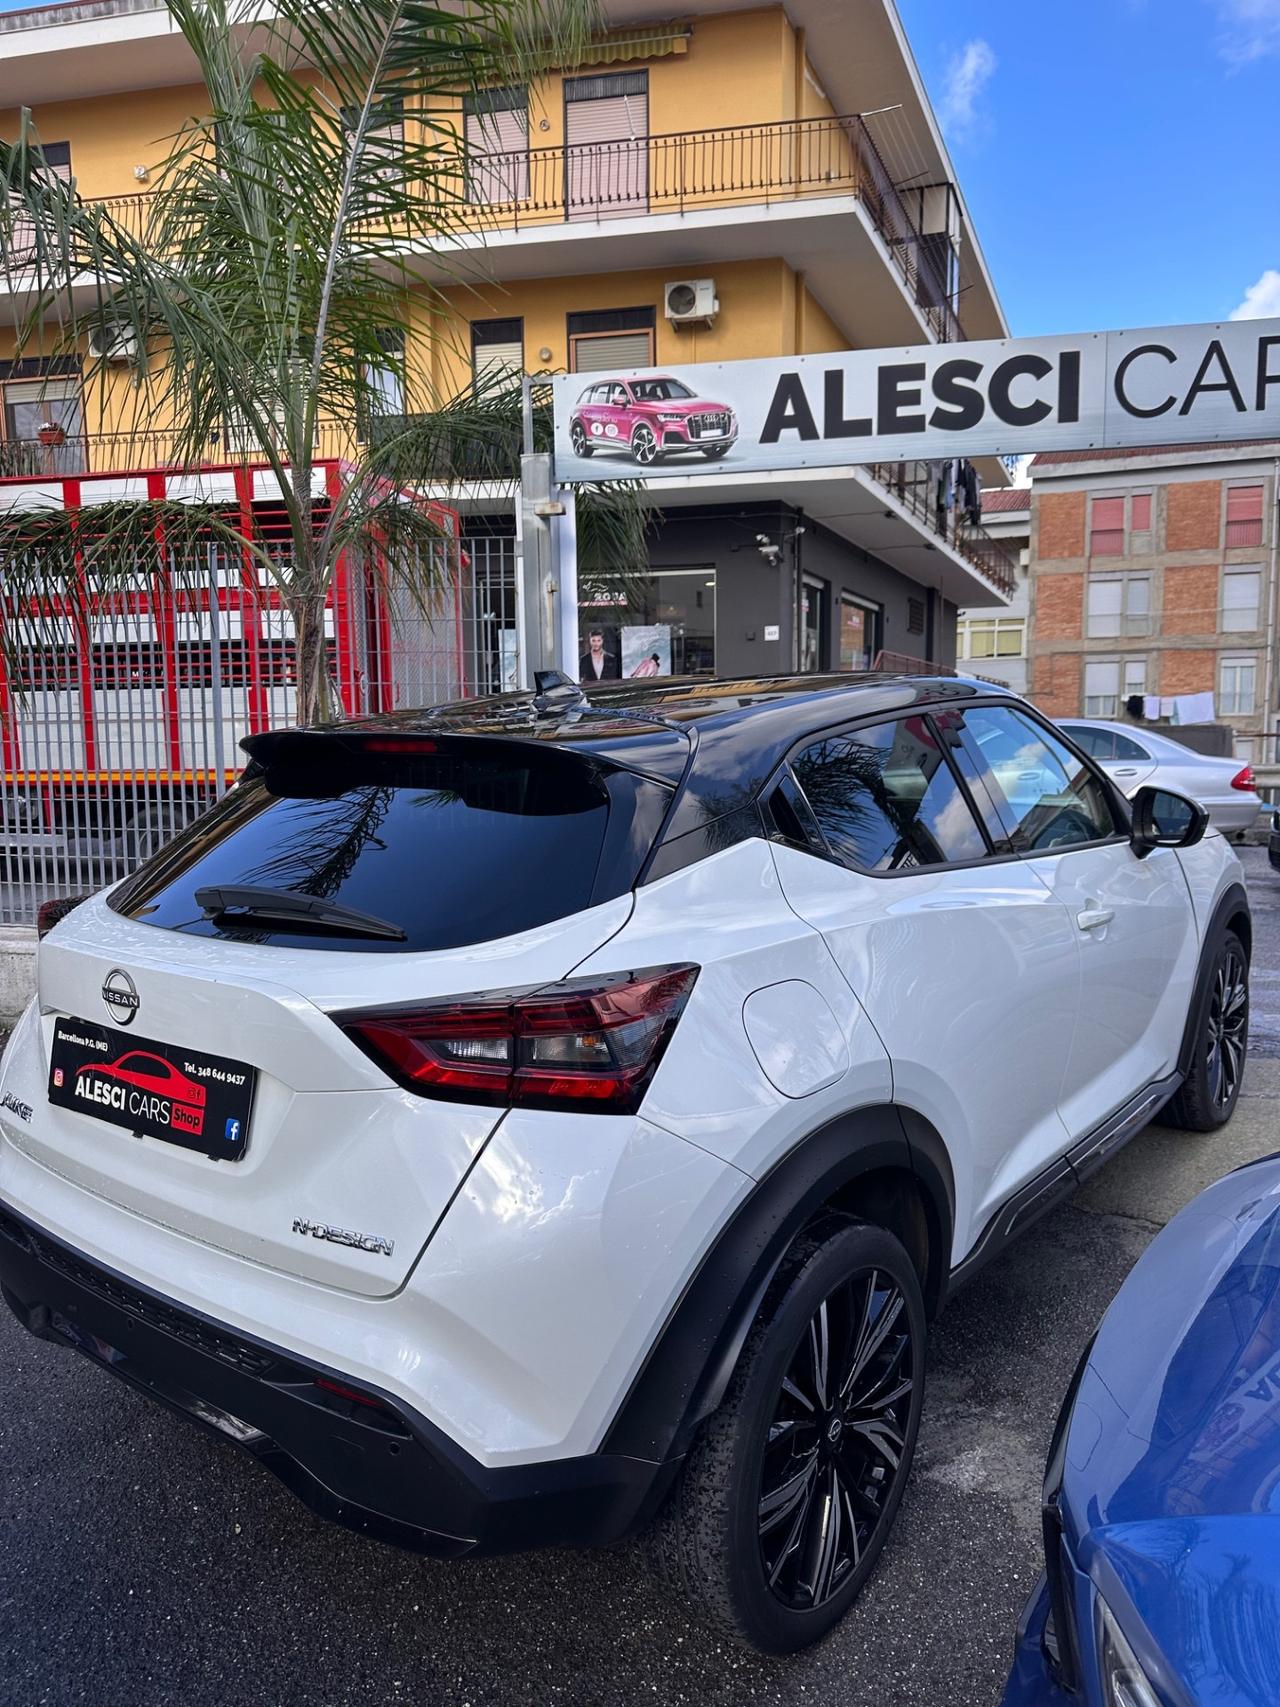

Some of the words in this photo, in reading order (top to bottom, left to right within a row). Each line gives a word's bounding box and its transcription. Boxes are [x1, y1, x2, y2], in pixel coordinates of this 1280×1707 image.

[758, 350, 1081, 444] ALESCI
[102, 988, 138, 1006] NISSAN
[58, 1030, 85, 1046] Barcellona
[197, 1067, 211, 1077] 348
[212, 1069, 226, 1082] 644
[226, 1073, 246, 1086] 9437
[74, 1075, 126, 1111] ALESCI
[129, 1091, 171, 1125] CARS
[173, 1107, 201, 1129] Shop
[292, 1216, 396, 1257] N-DESIGN
